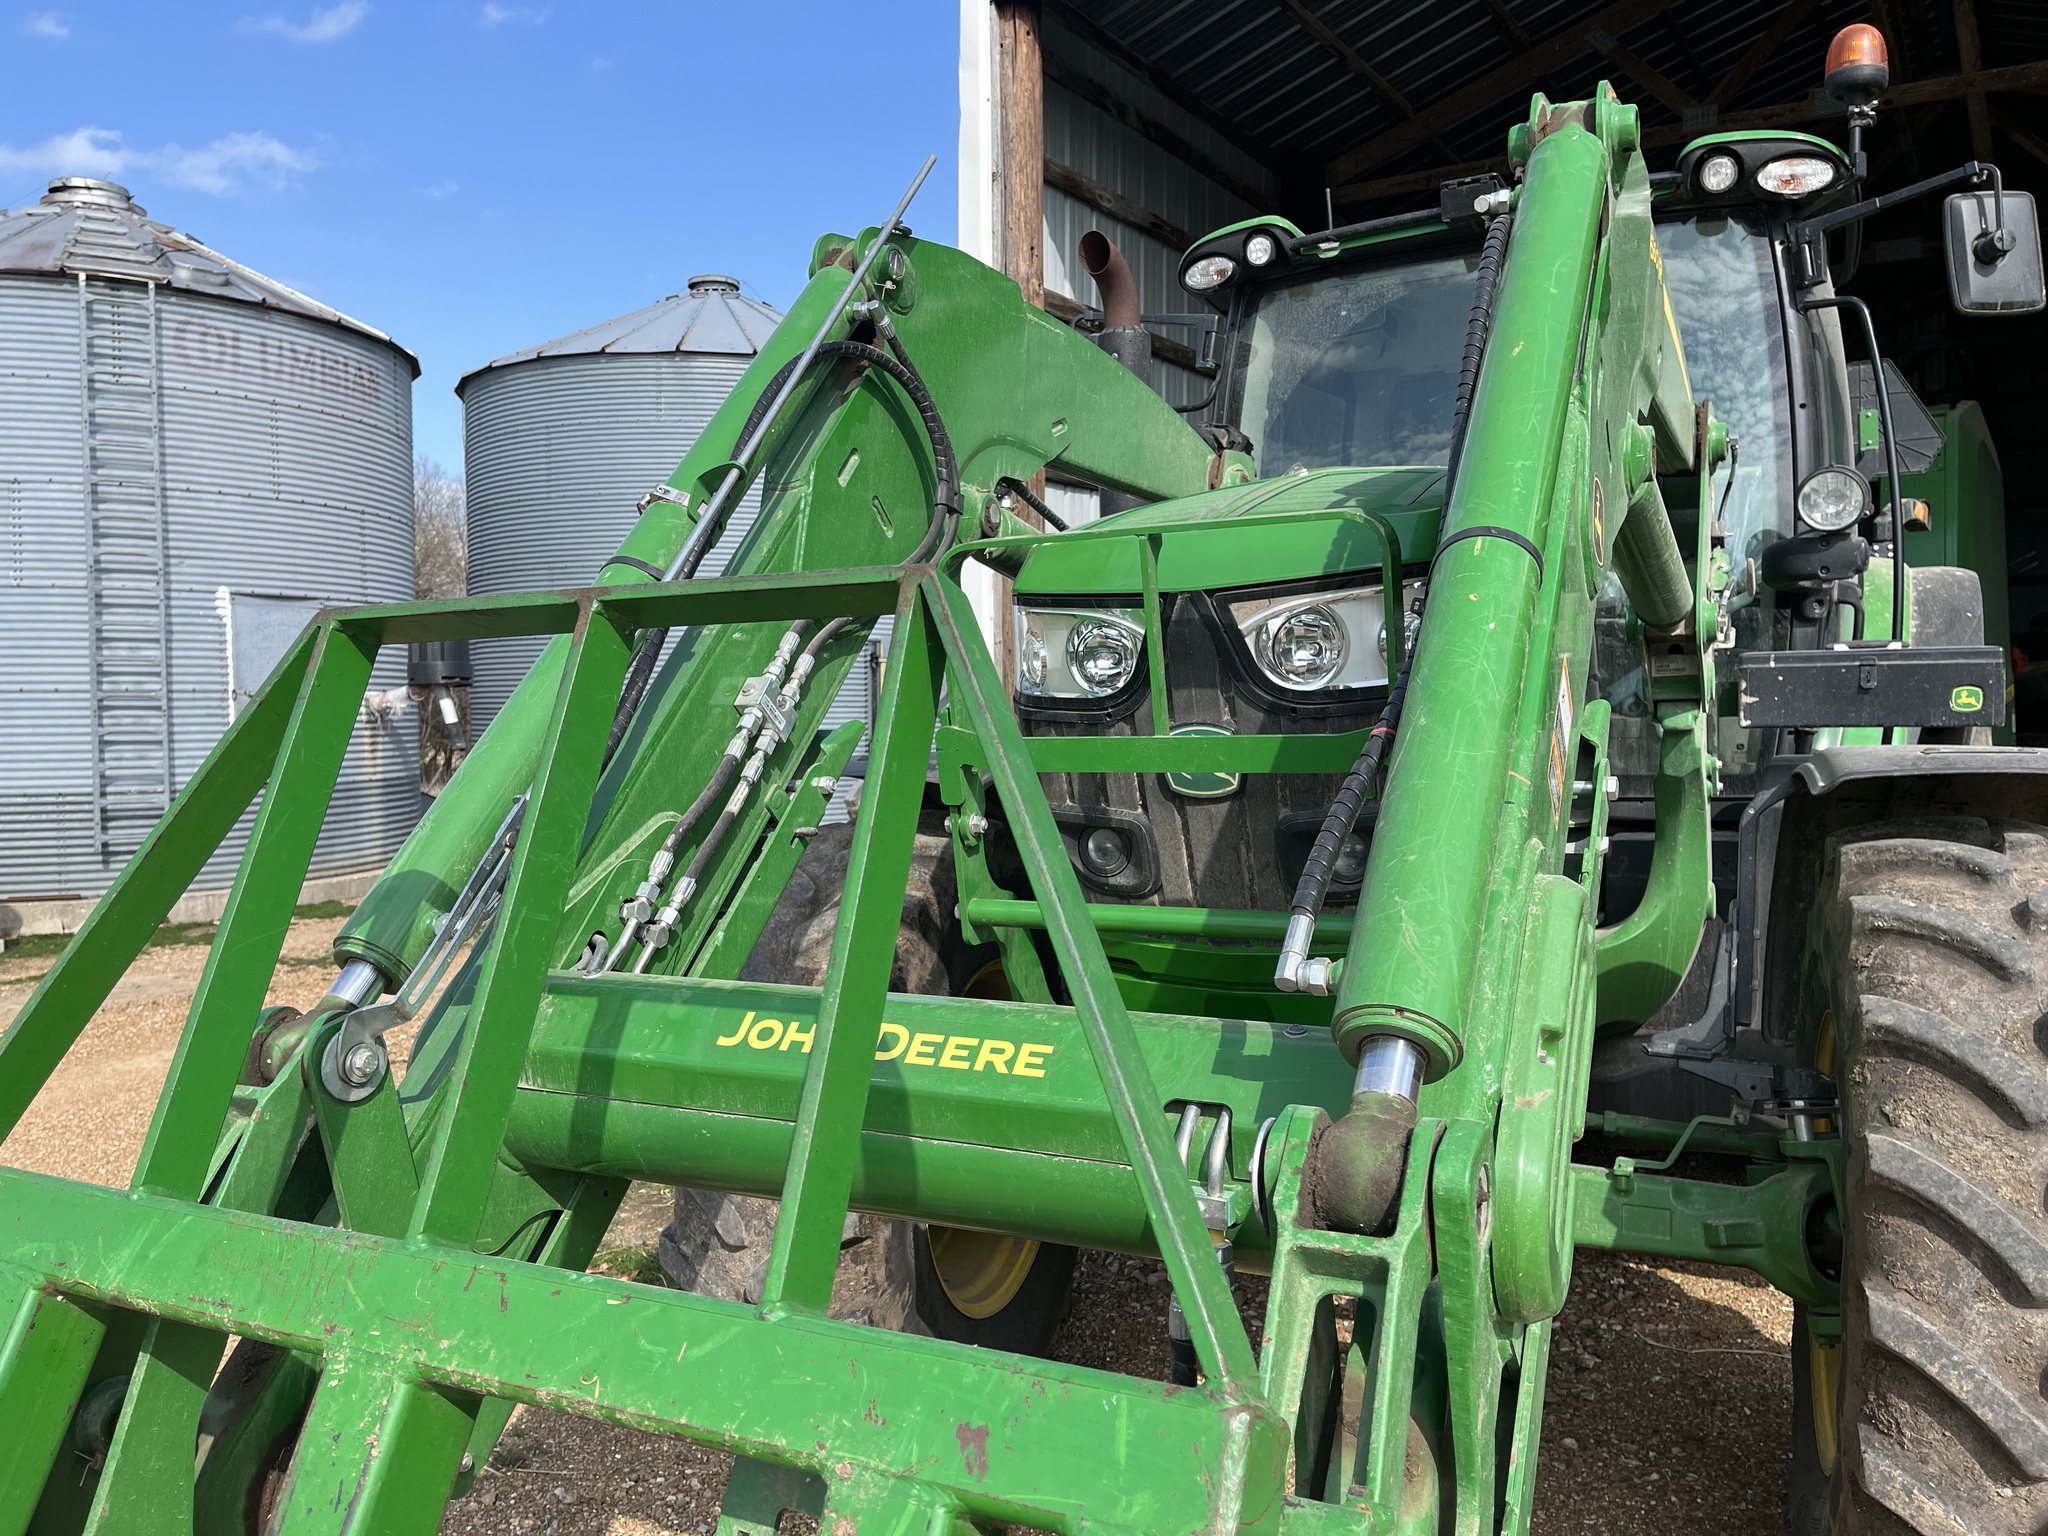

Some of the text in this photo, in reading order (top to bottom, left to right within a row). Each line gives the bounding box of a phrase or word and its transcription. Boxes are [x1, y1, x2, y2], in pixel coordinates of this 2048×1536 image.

[172, 320, 380, 401] COLUMBIAN
[716, 1011, 1054, 1077] JOH DEERE
